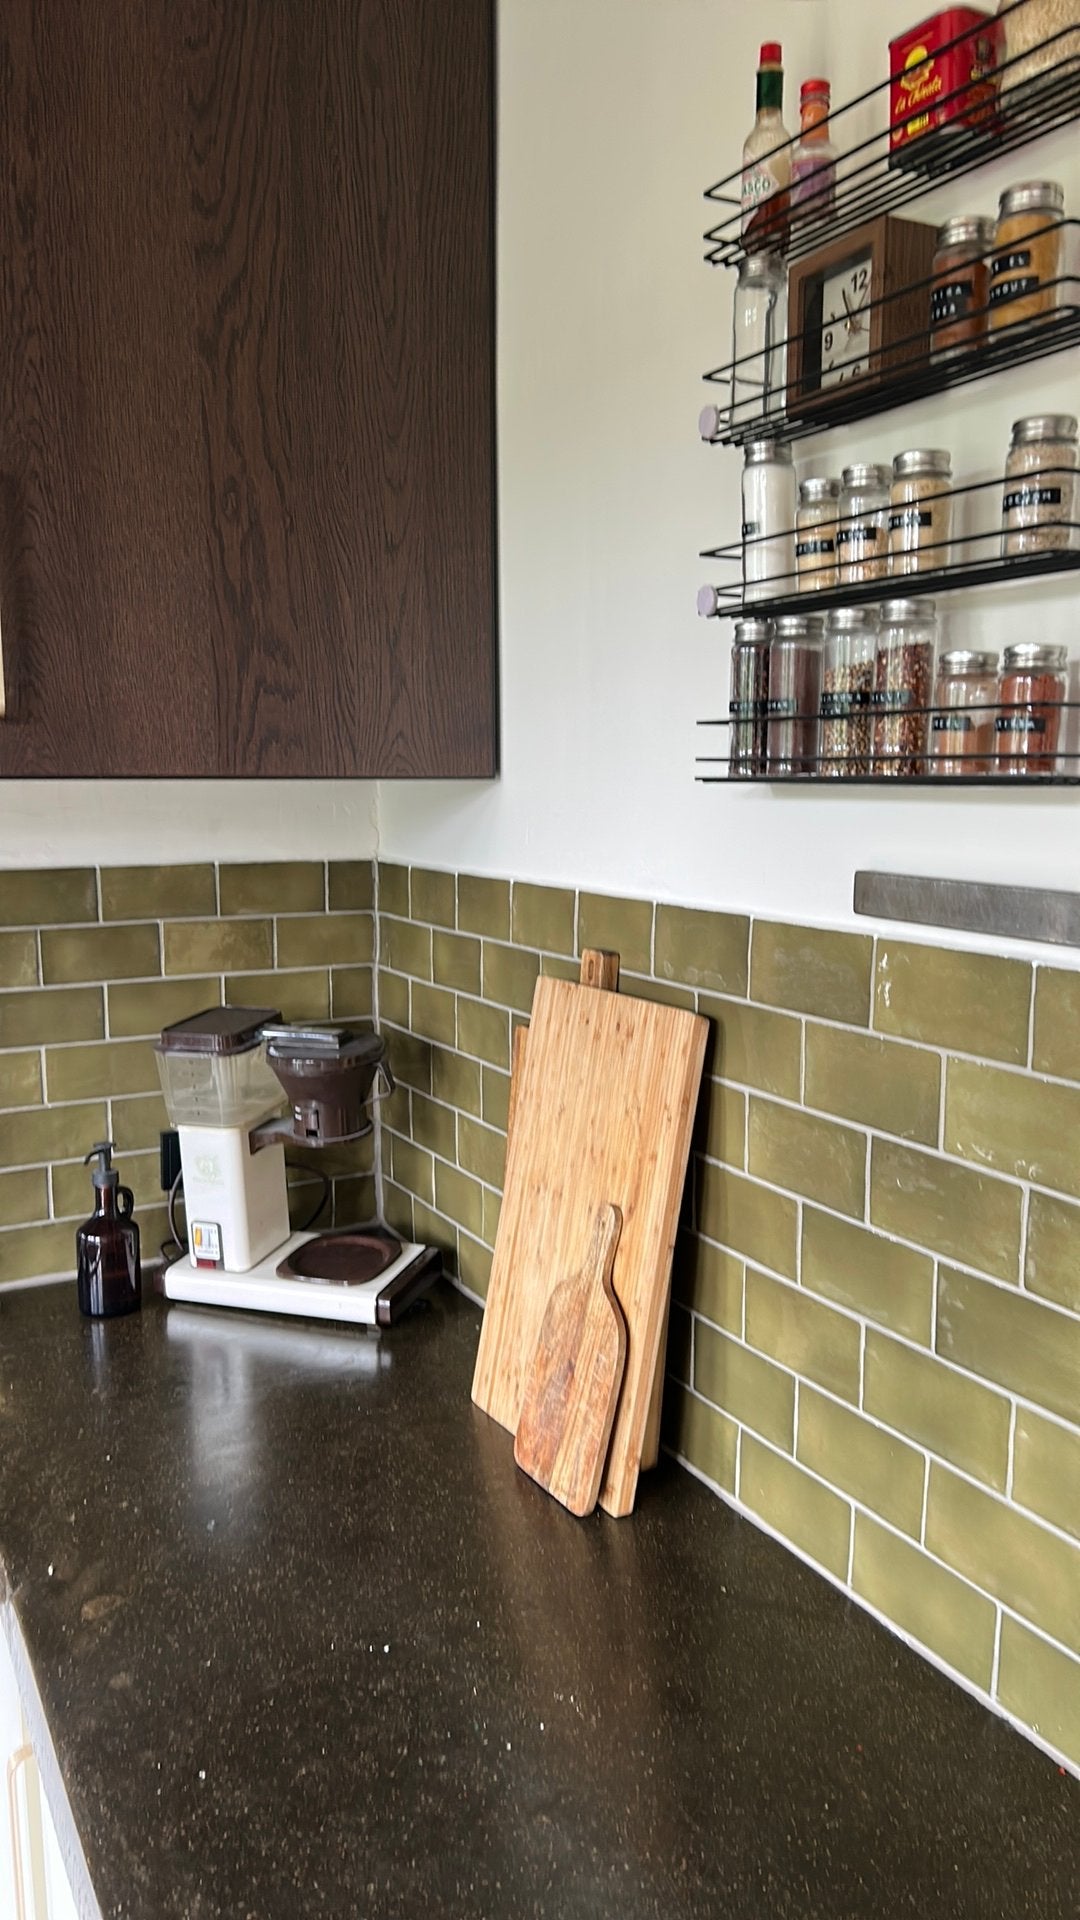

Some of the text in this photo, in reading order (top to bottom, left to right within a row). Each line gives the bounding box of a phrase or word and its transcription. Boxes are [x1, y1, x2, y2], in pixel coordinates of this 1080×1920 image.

[742, 177, 771, 196] ASCO
[850, 268, 868, 293] 12
[824, 332, 834, 351] 9
